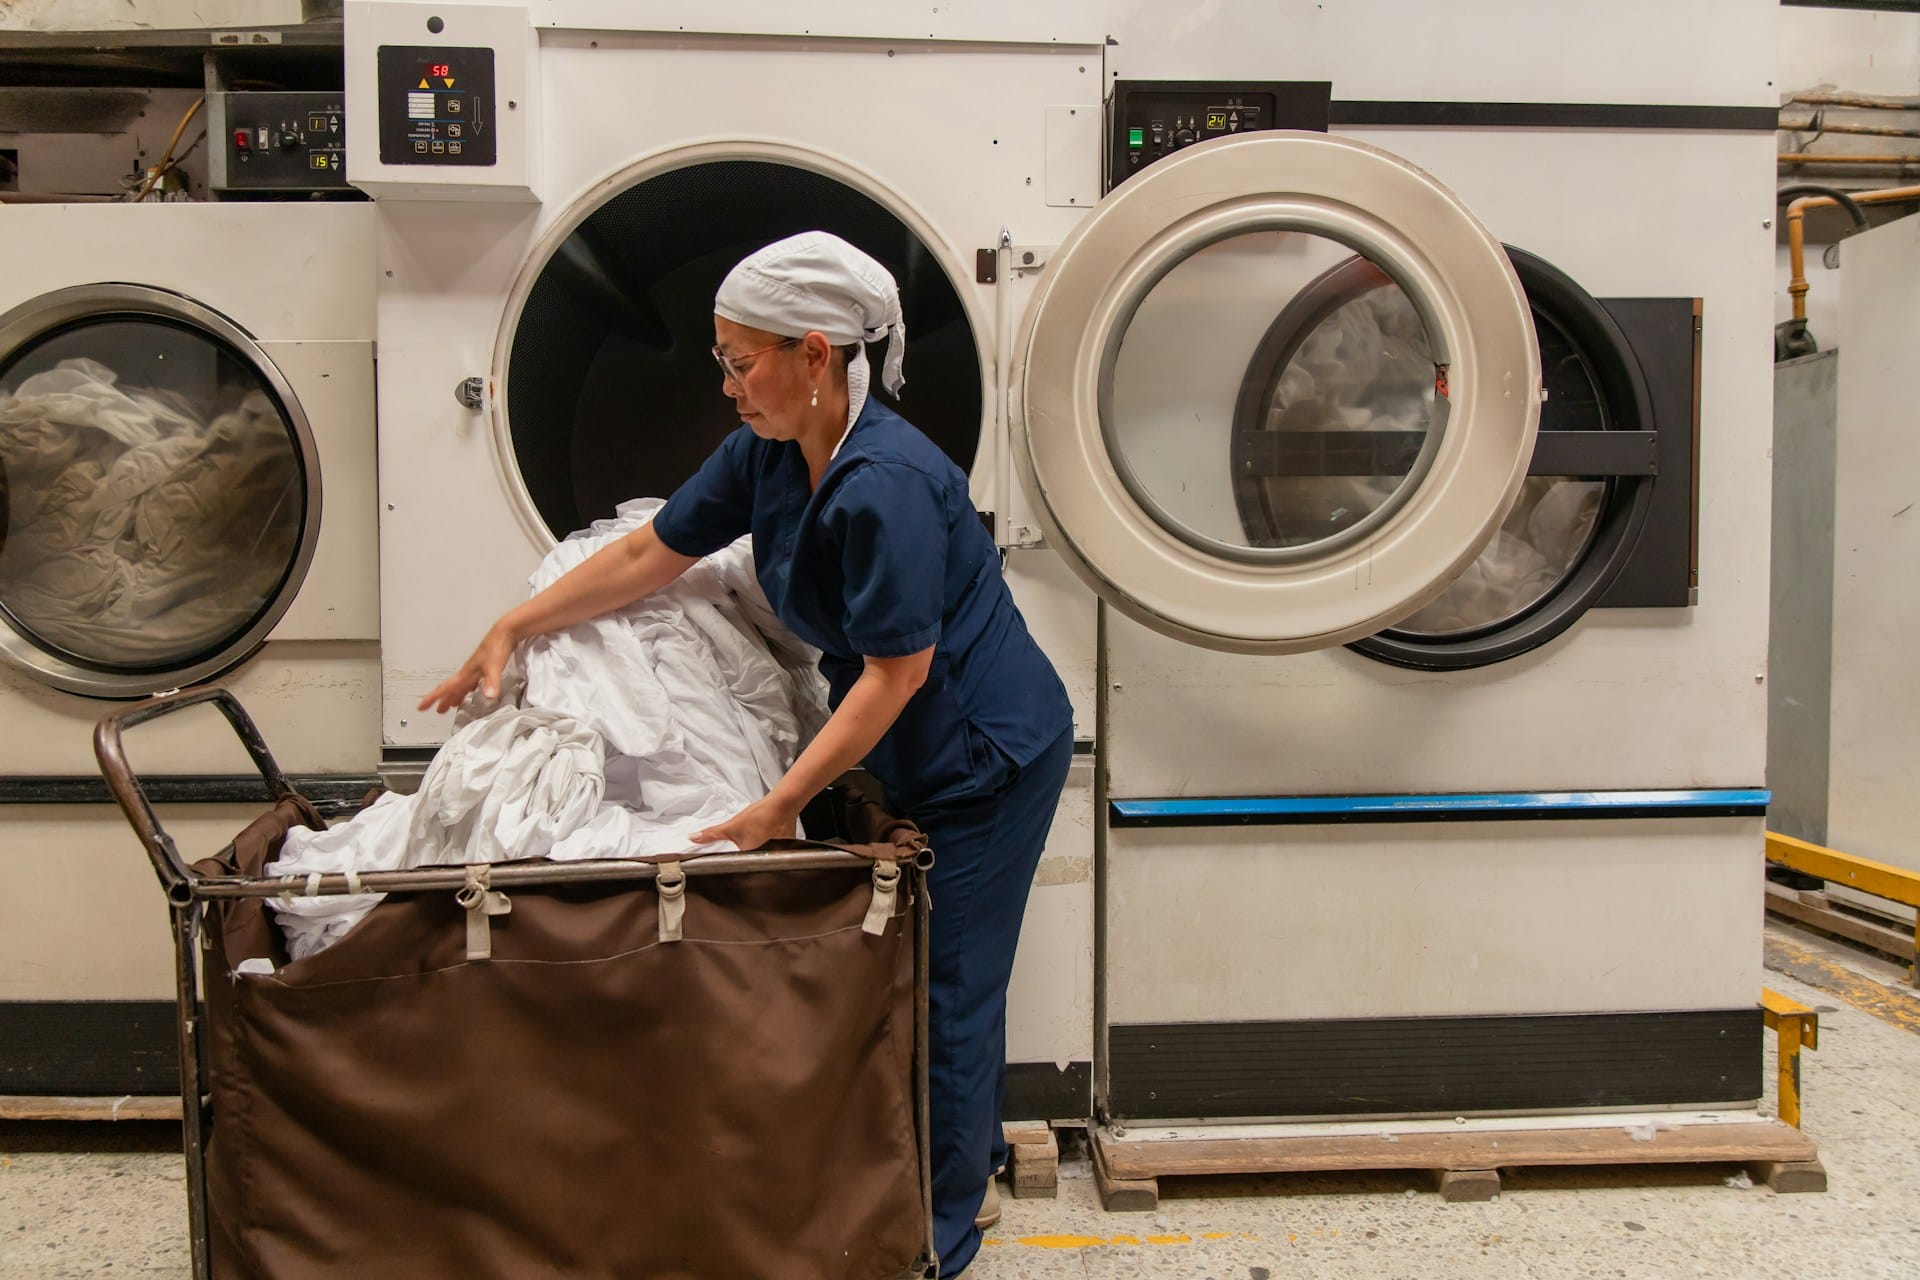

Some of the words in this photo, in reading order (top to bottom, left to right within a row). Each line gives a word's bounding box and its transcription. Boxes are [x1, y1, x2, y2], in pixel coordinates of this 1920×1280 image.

[432, 65, 449, 77] 58
[1208, 115, 1225, 127] 24
[315, 156, 327, 167] 15
